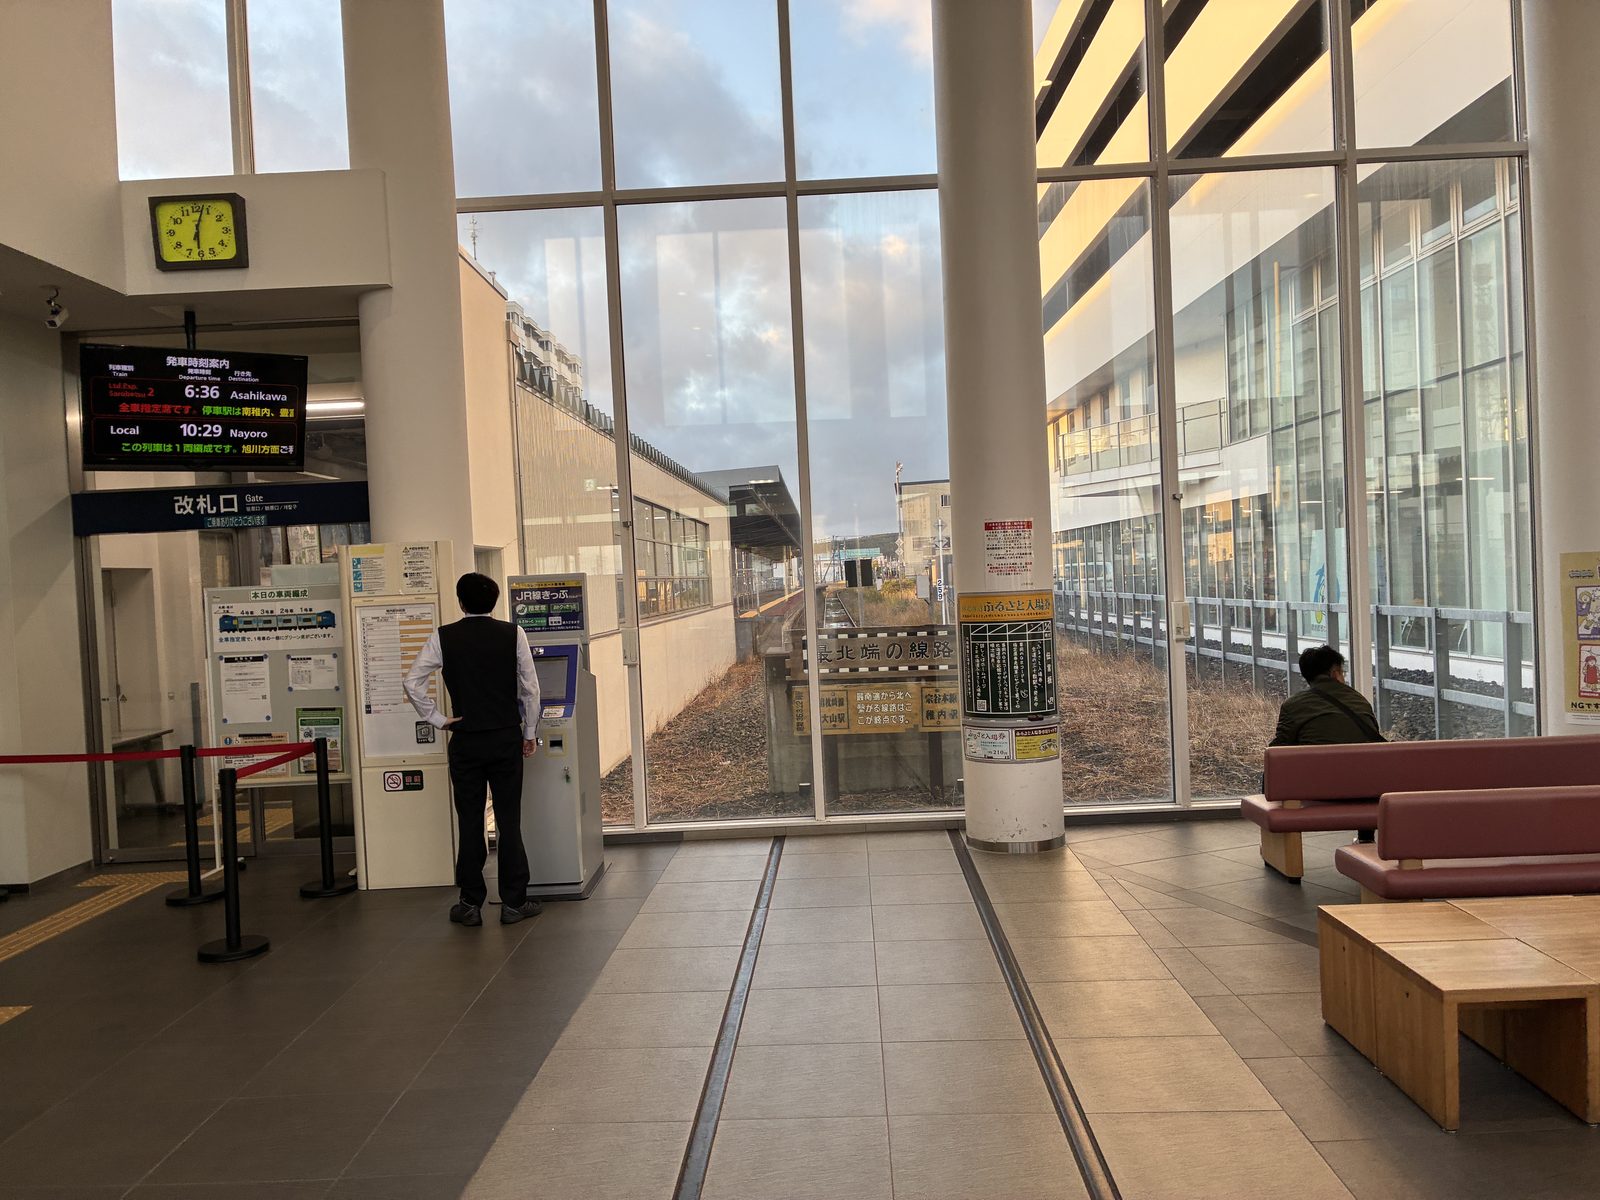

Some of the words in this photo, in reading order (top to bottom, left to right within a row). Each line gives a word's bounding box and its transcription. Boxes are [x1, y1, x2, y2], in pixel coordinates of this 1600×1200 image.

[166, 356, 230, 369] 発車時刻案内
[147, 387, 155, 396] 2
[184, 384, 220, 398] 6:36
[230, 391, 287, 401] Asahikawa
[110, 425, 139, 435] Local
[179, 423, 222, 437] 10:29
[229, 429, 268, 440] Nayoro
[173, 494, 239, 515] 改札口
[245, 494, 264, 502] Gate
[251, 590, 308, 599] 本日の車両編成
[516, 589, 569, 601] JR線きっぷ
[983, 598, 1050, 612] ふるさと入場券
[818, 641, 954, 663] 最北端の線路
[857, 714, 909, 725] こが終点です。
